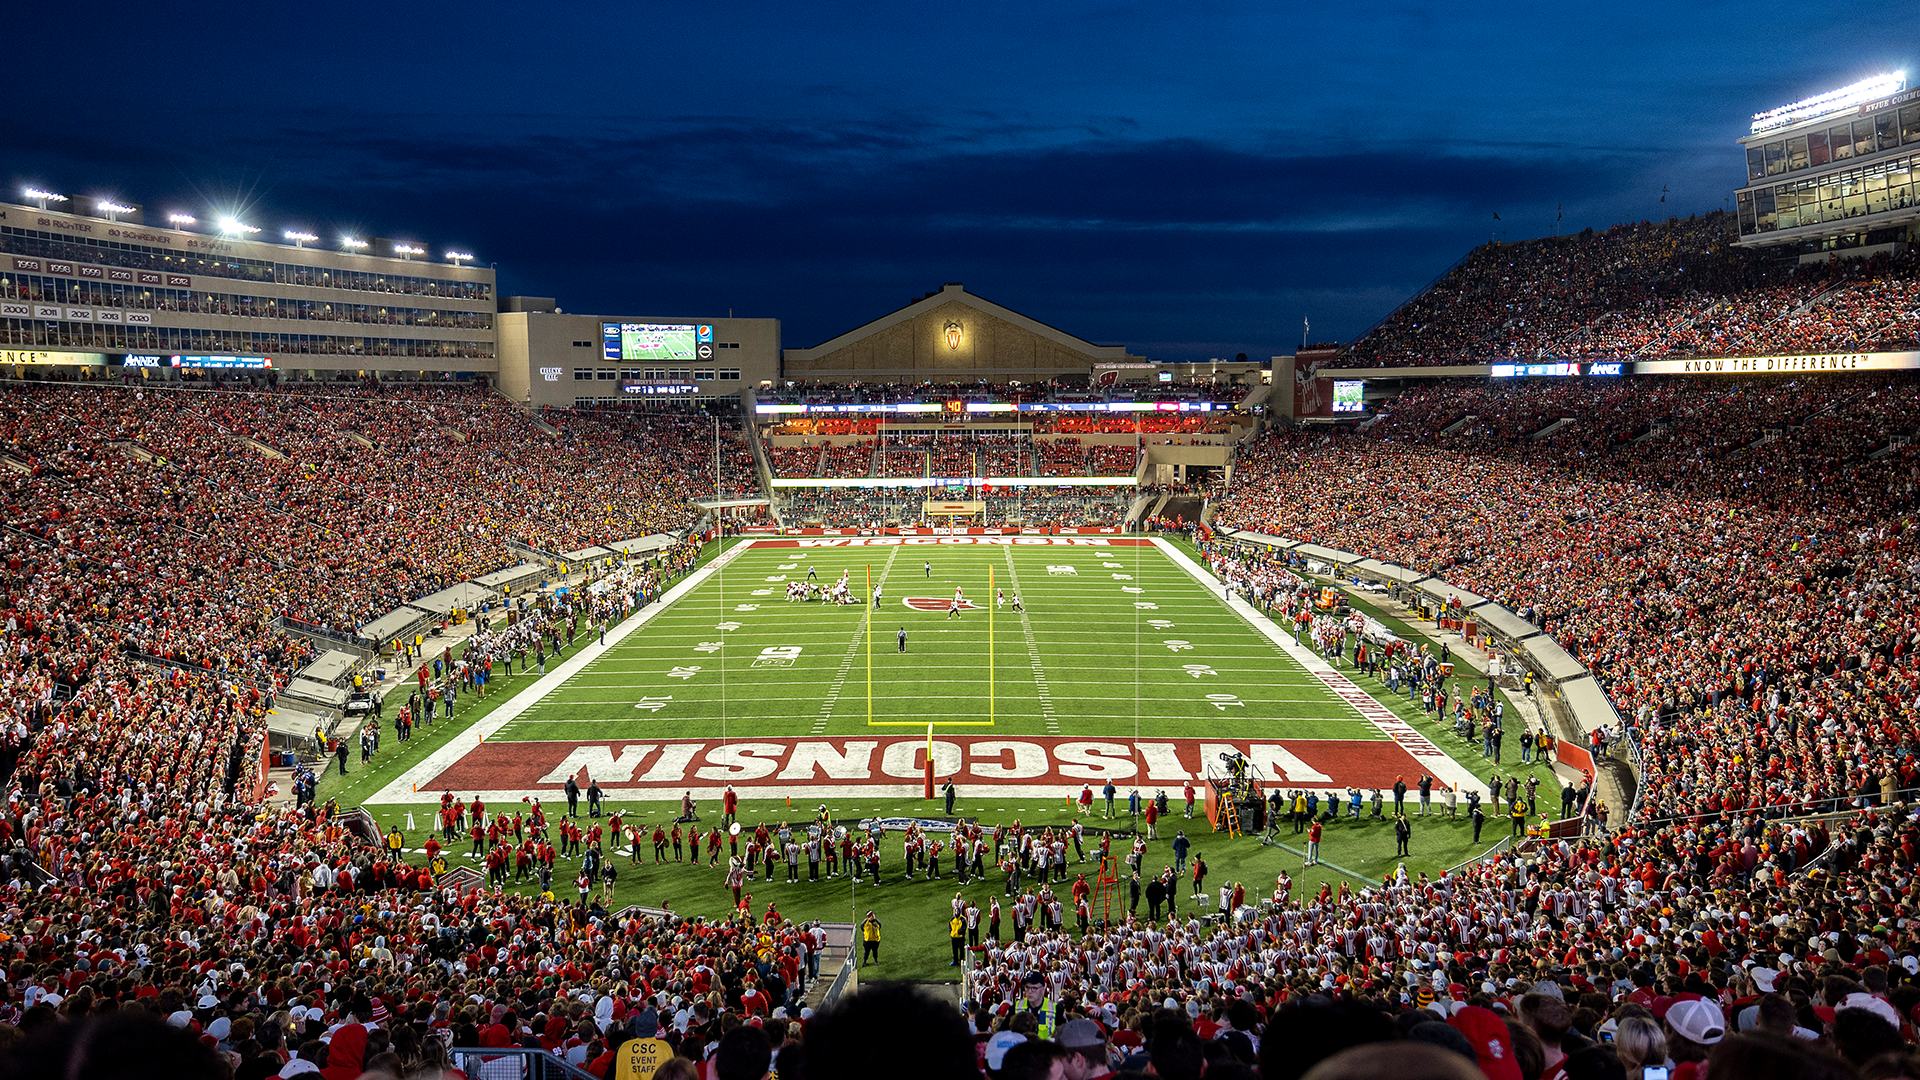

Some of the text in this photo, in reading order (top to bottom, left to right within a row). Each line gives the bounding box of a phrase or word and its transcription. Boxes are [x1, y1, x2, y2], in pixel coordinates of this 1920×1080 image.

[1865, 100, 1890, 112] EVJUE
[53, 220, 92, 232] RICHTER
[122, 231, 171, 244] SCHREINER
[18, 261, 39, 270] 1993
[50, 264, 71, 274] 1998
[82, 267, 102, 276] 1999
[111, 271, 131, 280] 2010
[142, 274, 159, 282] 2011
[170, 277, 188, 285] 2012
[4, 305, 28, 314] 2000
[40, 308, 57, 316] 2011
[71, 310, 90, 318] 2012
[129, 314, 150, 322] 2020
[947, 333, 959, 348] W
[1685, 361, 1724, 371] KNOW
[1733, 360, 1757, 370] THE
[947, 401, 961, 412] 40
[667, 666, 702, 676] 20
[1181, 664, 1218, 675] 20
[634, 695, 672, 708] 10
[1205, 694, 1245, 707] 10
[1338, 691, 1403, 724] ALVAREZ
[537, 742, 1333, 785] WISCONSIN
[632, 1043, 656, 1054] CSC
[631, 1056, 657, 1064] EVENT
[632, 1065, 656, 1073] STAFF
